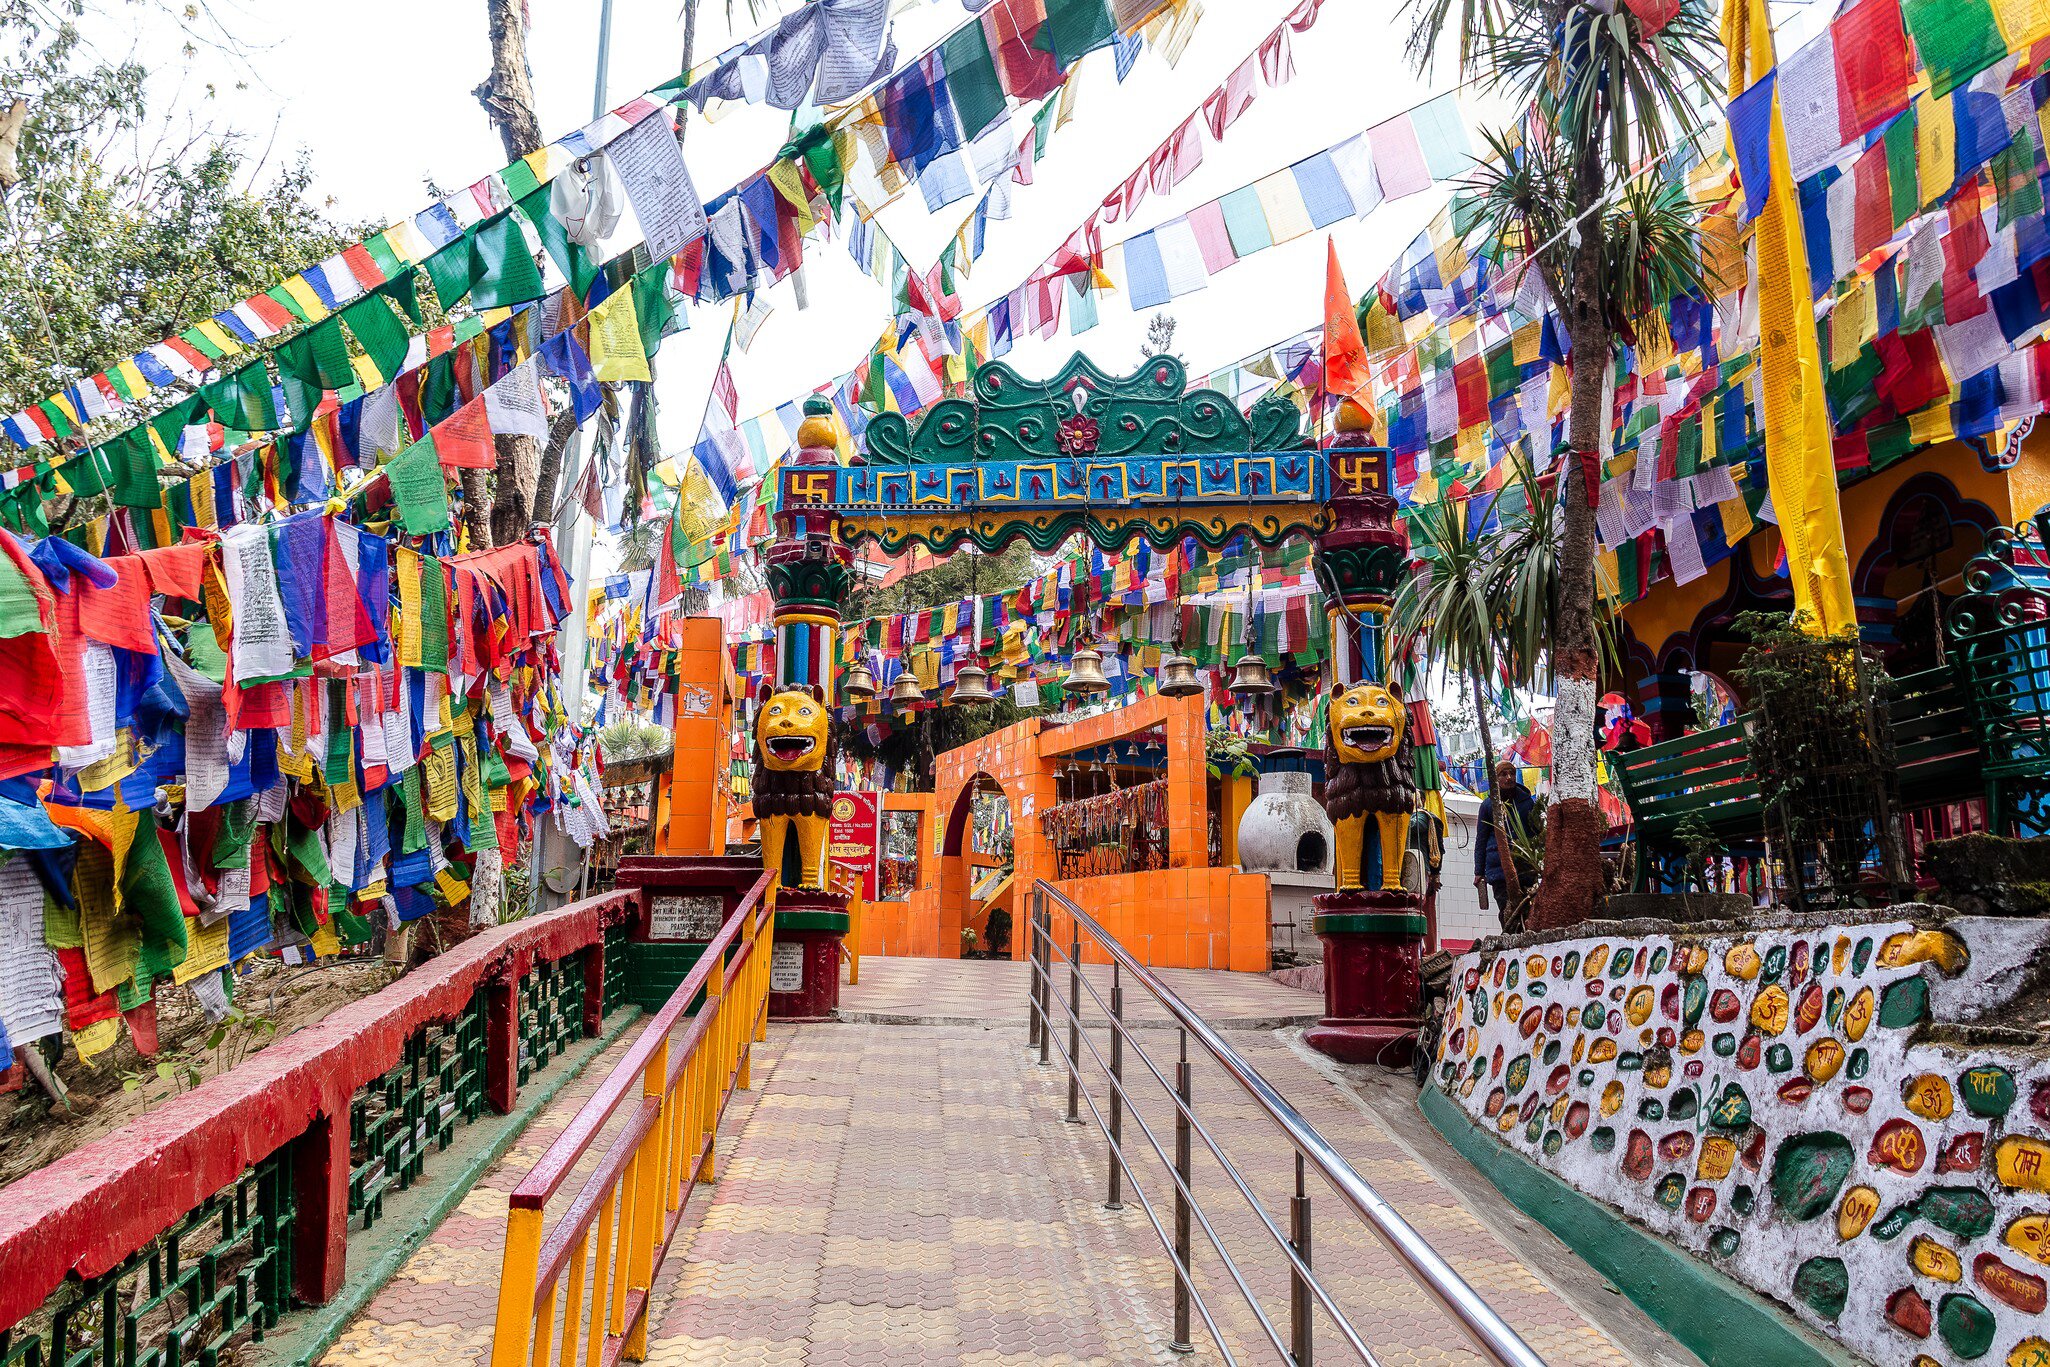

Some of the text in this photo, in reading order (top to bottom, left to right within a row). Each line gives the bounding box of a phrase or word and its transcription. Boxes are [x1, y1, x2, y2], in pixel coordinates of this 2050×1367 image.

[1919, 1080, 1943, 1115] ॐ
[1969, 1071, 2004, 1096] राम
[1845, 1196, 1872, 1227] OM
